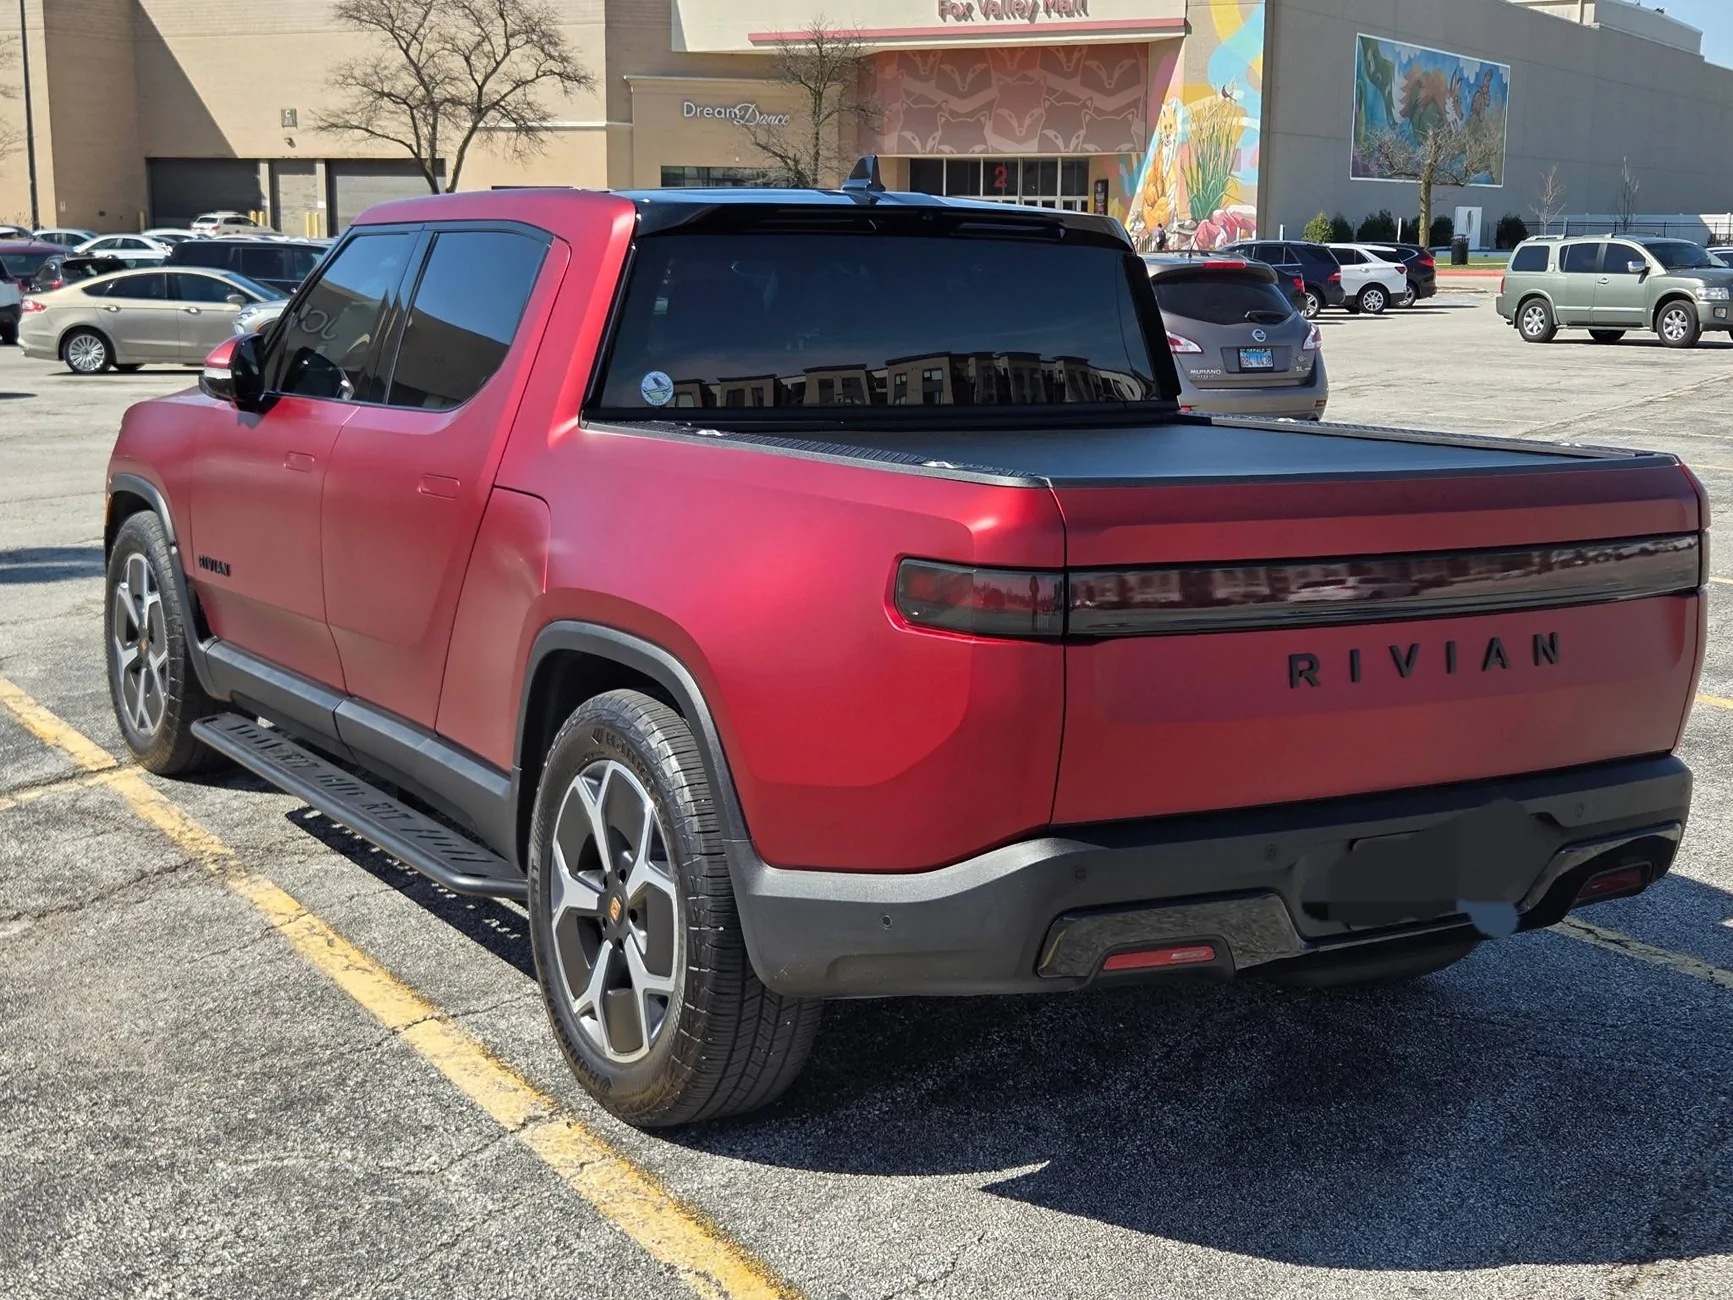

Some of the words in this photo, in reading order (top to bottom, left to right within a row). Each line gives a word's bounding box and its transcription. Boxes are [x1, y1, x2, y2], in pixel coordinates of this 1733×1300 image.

[938, 0, 972, 21] Fox
[978, 0, 1039, 24] Valley
[1043, 0, 1088, 19] Mall
[683, 101, 740, 118] Dream
[733, 103, 790, 125] Dance
[994, 165, 1008, 188] 2
[198, 555, 231, 577] RIVIAN
[1288, 632, 1560, 689] RIVIAN
